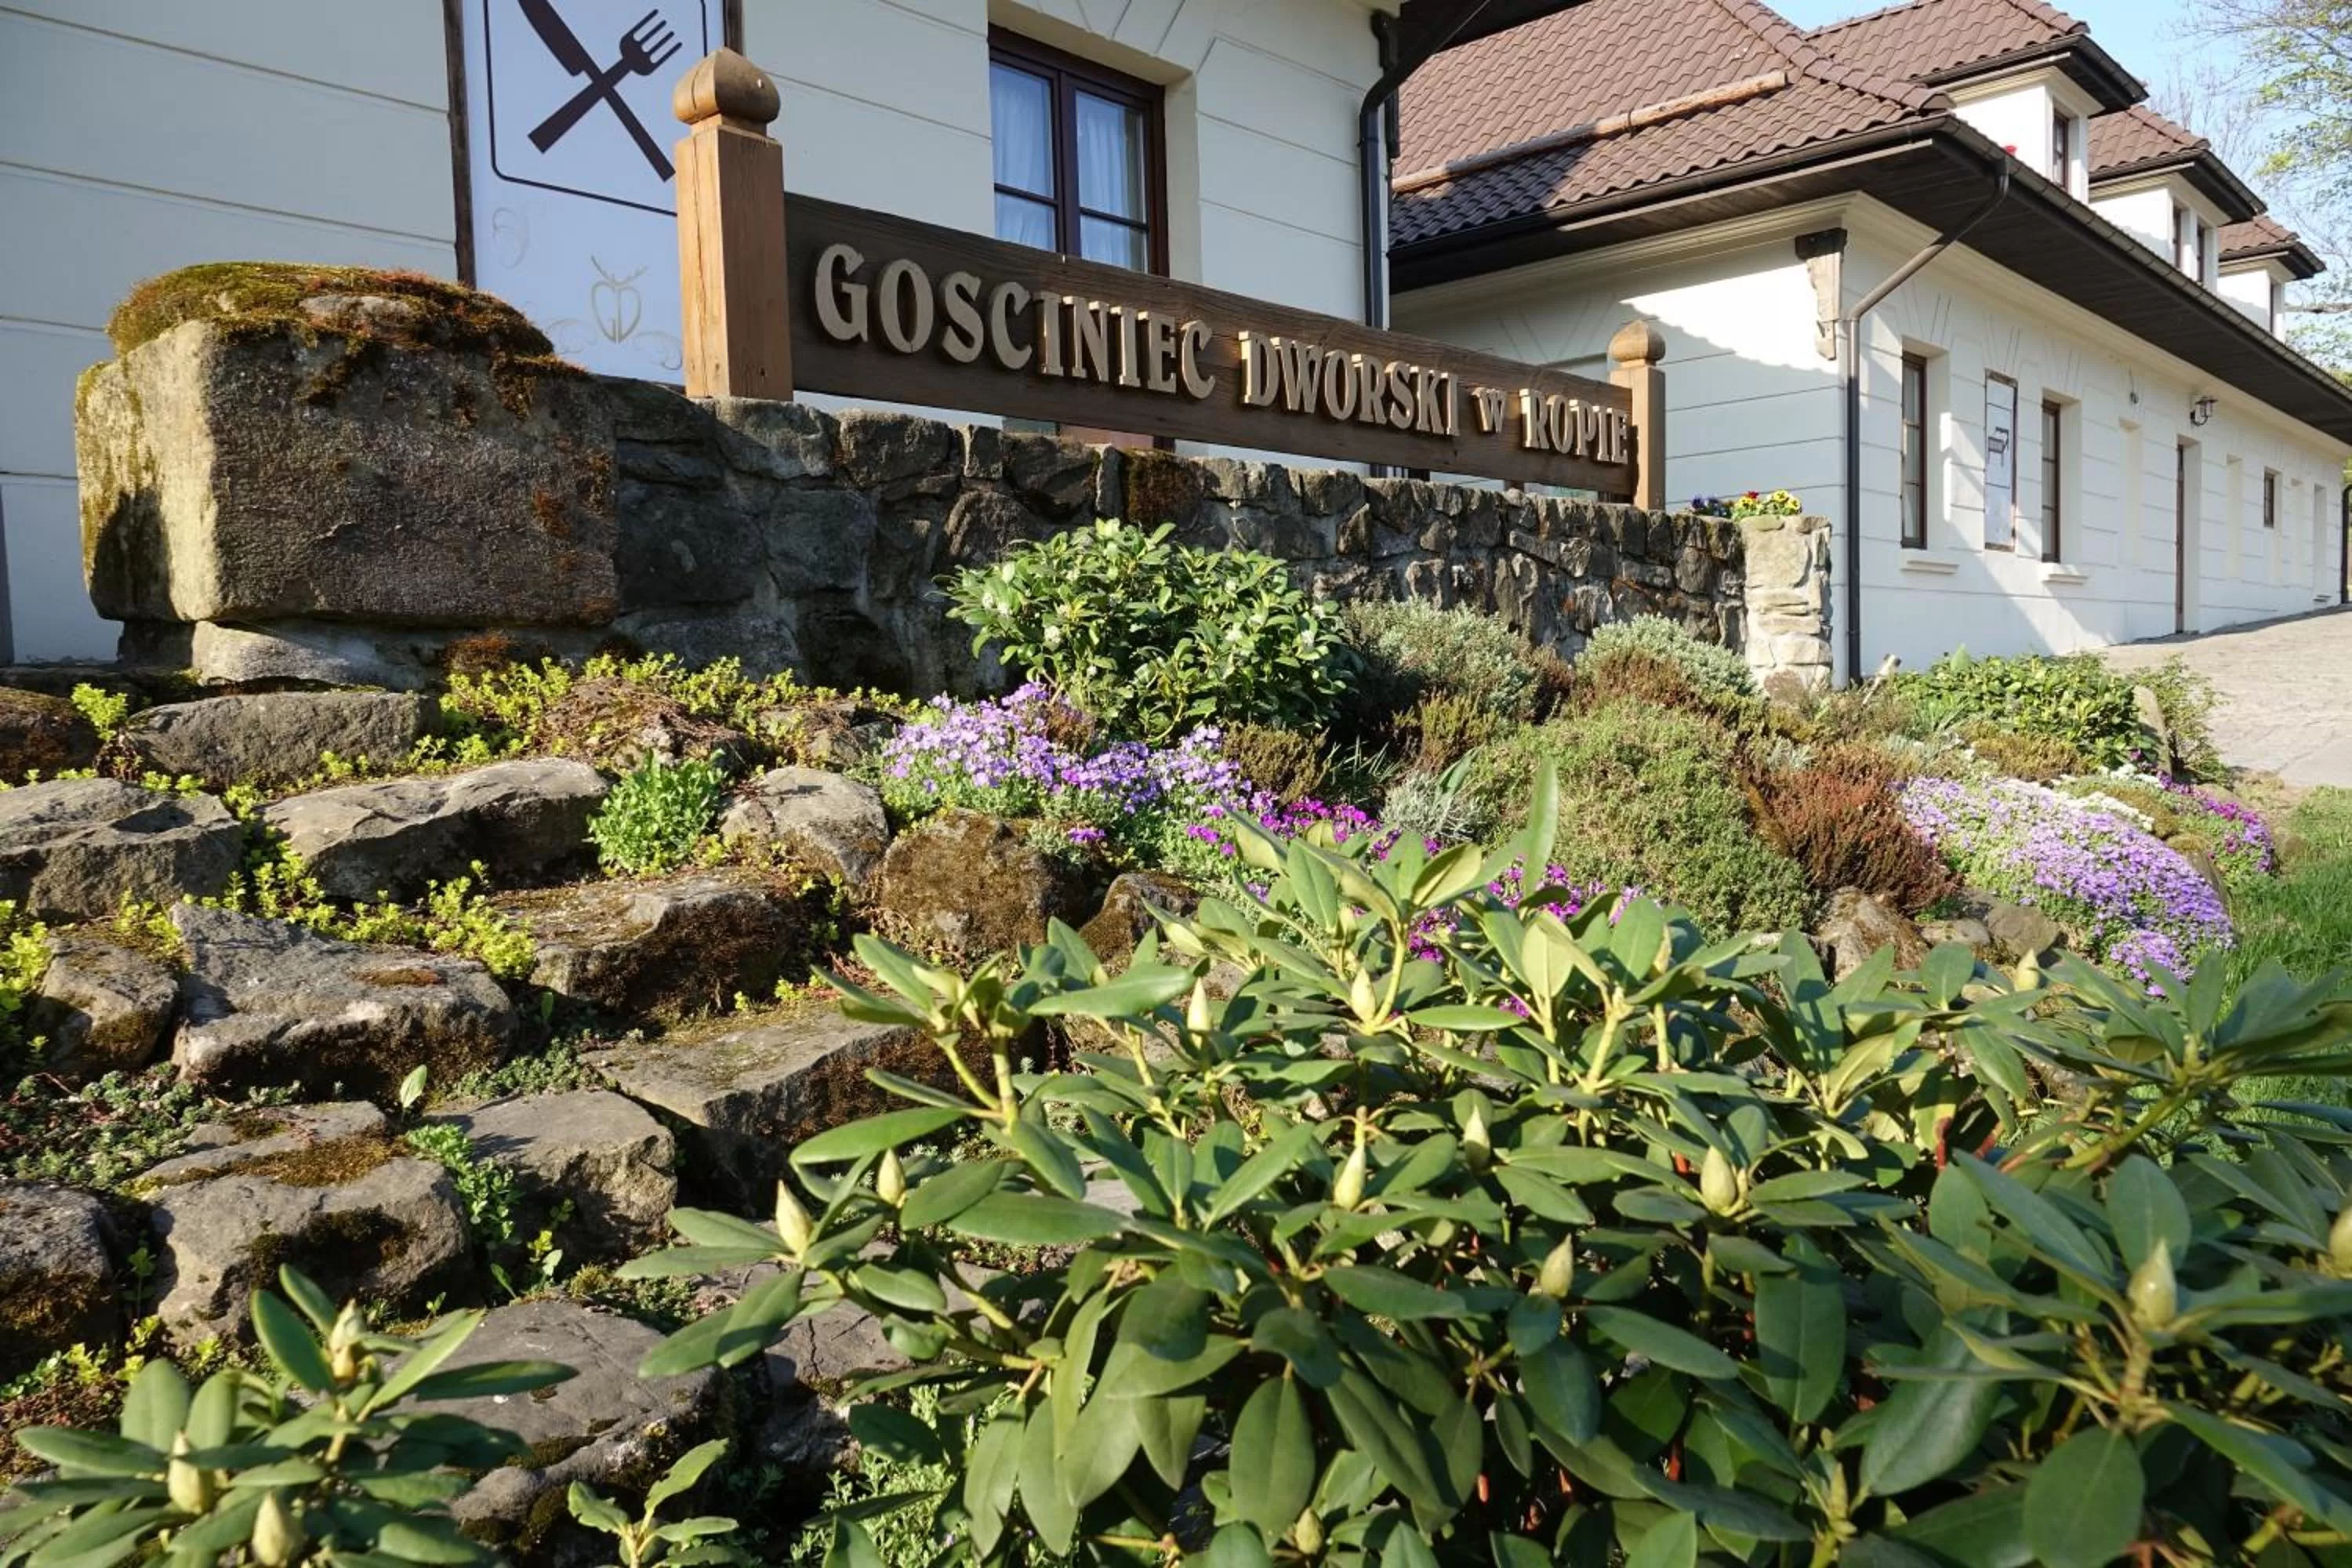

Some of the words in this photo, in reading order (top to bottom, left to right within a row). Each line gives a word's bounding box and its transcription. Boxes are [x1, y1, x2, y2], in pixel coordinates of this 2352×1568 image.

[814, 243, 1216, 399] GOSCINIEC
[1238, 330, 1460, 436] DWORSKI
[1519, 388, 1628, 464] ROPIE
